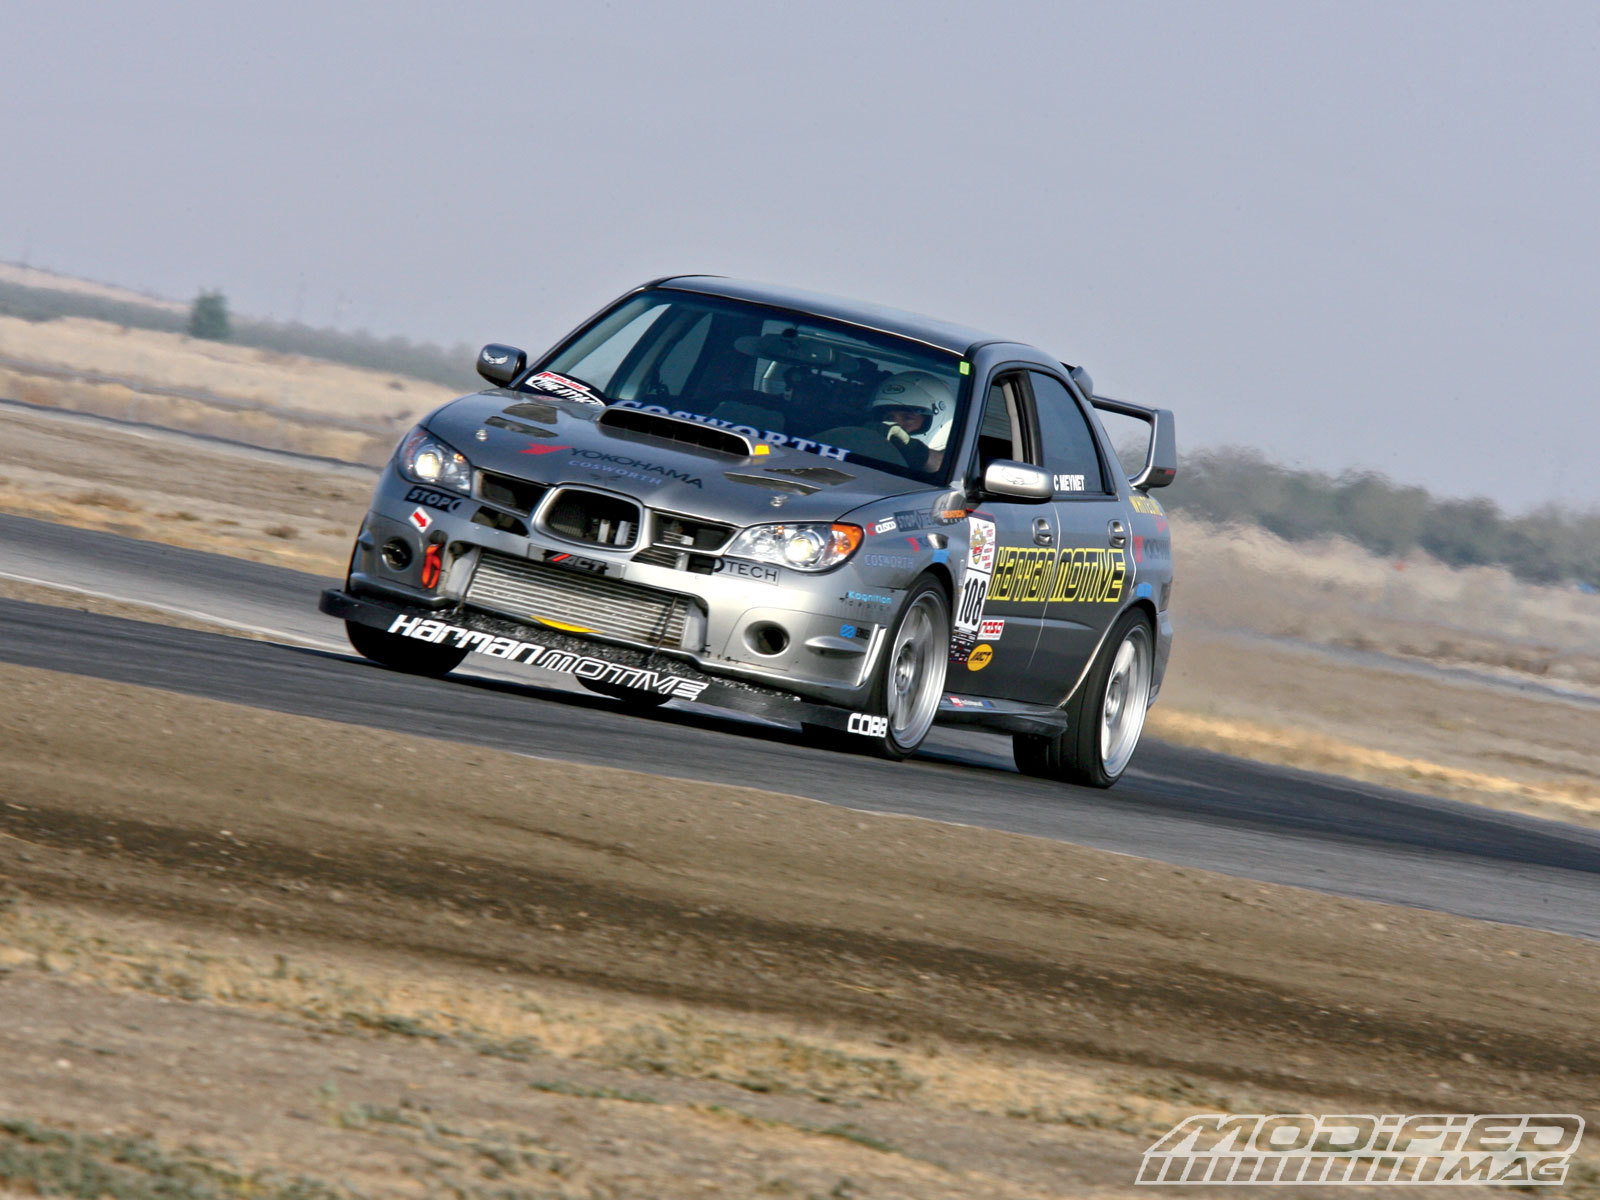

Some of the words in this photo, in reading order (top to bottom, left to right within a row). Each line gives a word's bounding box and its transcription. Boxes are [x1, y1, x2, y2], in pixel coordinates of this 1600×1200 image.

[568, 460, 662, 485] COSWORTH
[570, 447, 703, 489] YOKOHAMA
[1053, 474, 1060, 491] C
[727, 559, 777, 582] TECH
[959, 577, 987, 627] 108
[847, 712, 888, 738] COBB
